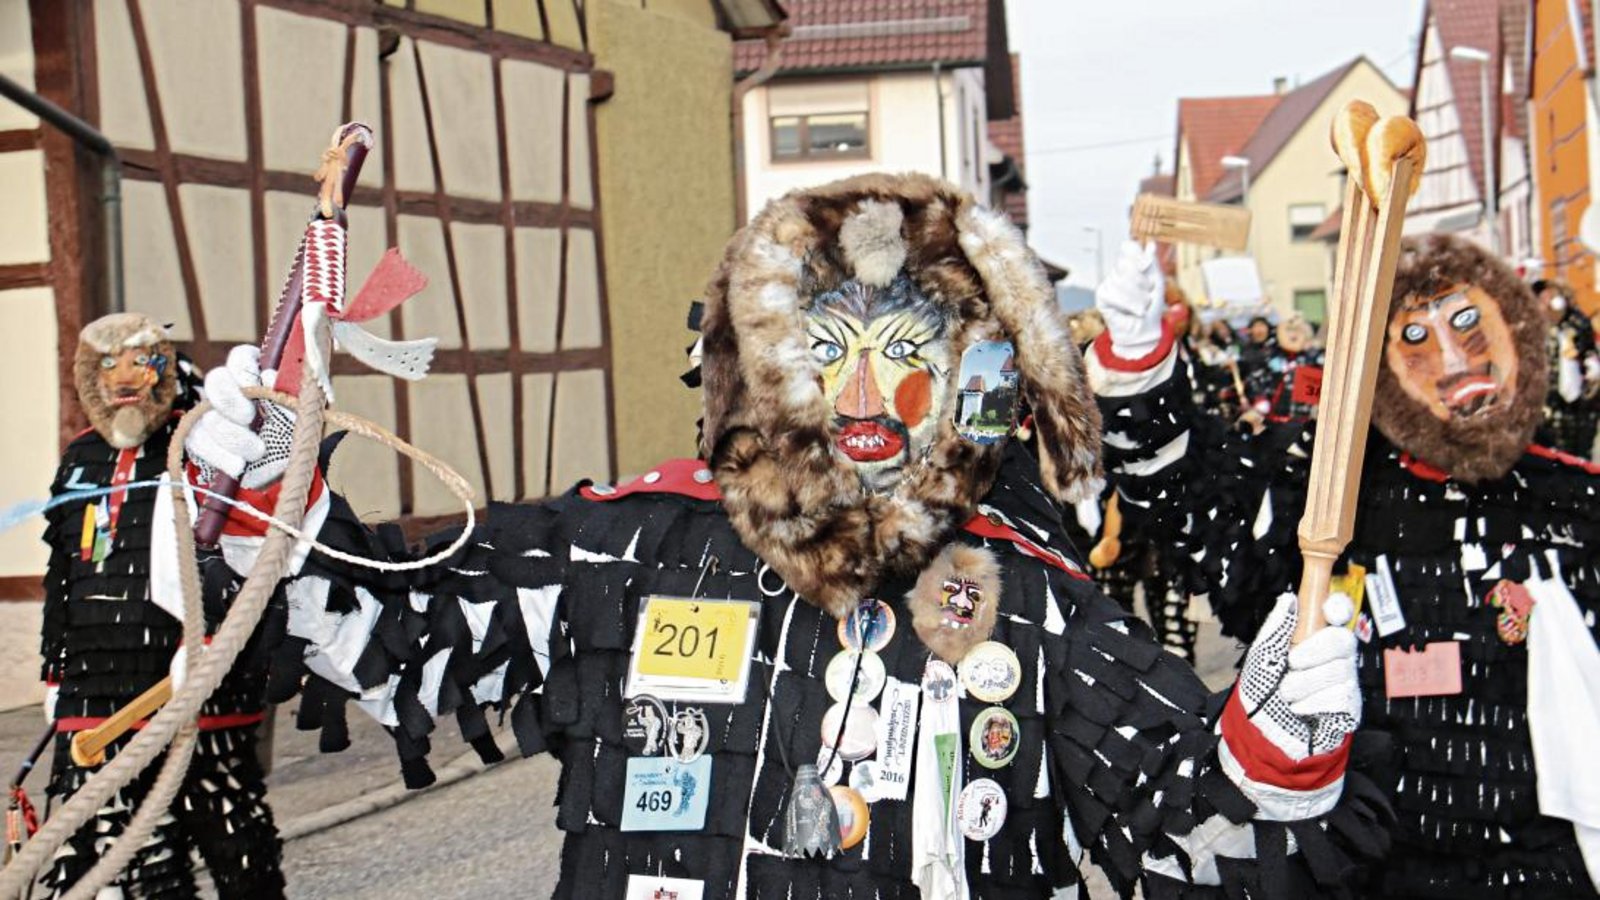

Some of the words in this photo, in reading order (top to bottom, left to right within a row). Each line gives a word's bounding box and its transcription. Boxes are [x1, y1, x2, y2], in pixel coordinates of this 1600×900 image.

[653, 623, 718, 659] 201
[879, 769, 905, 784] 2016
[636, 790, 672, 812] 469
